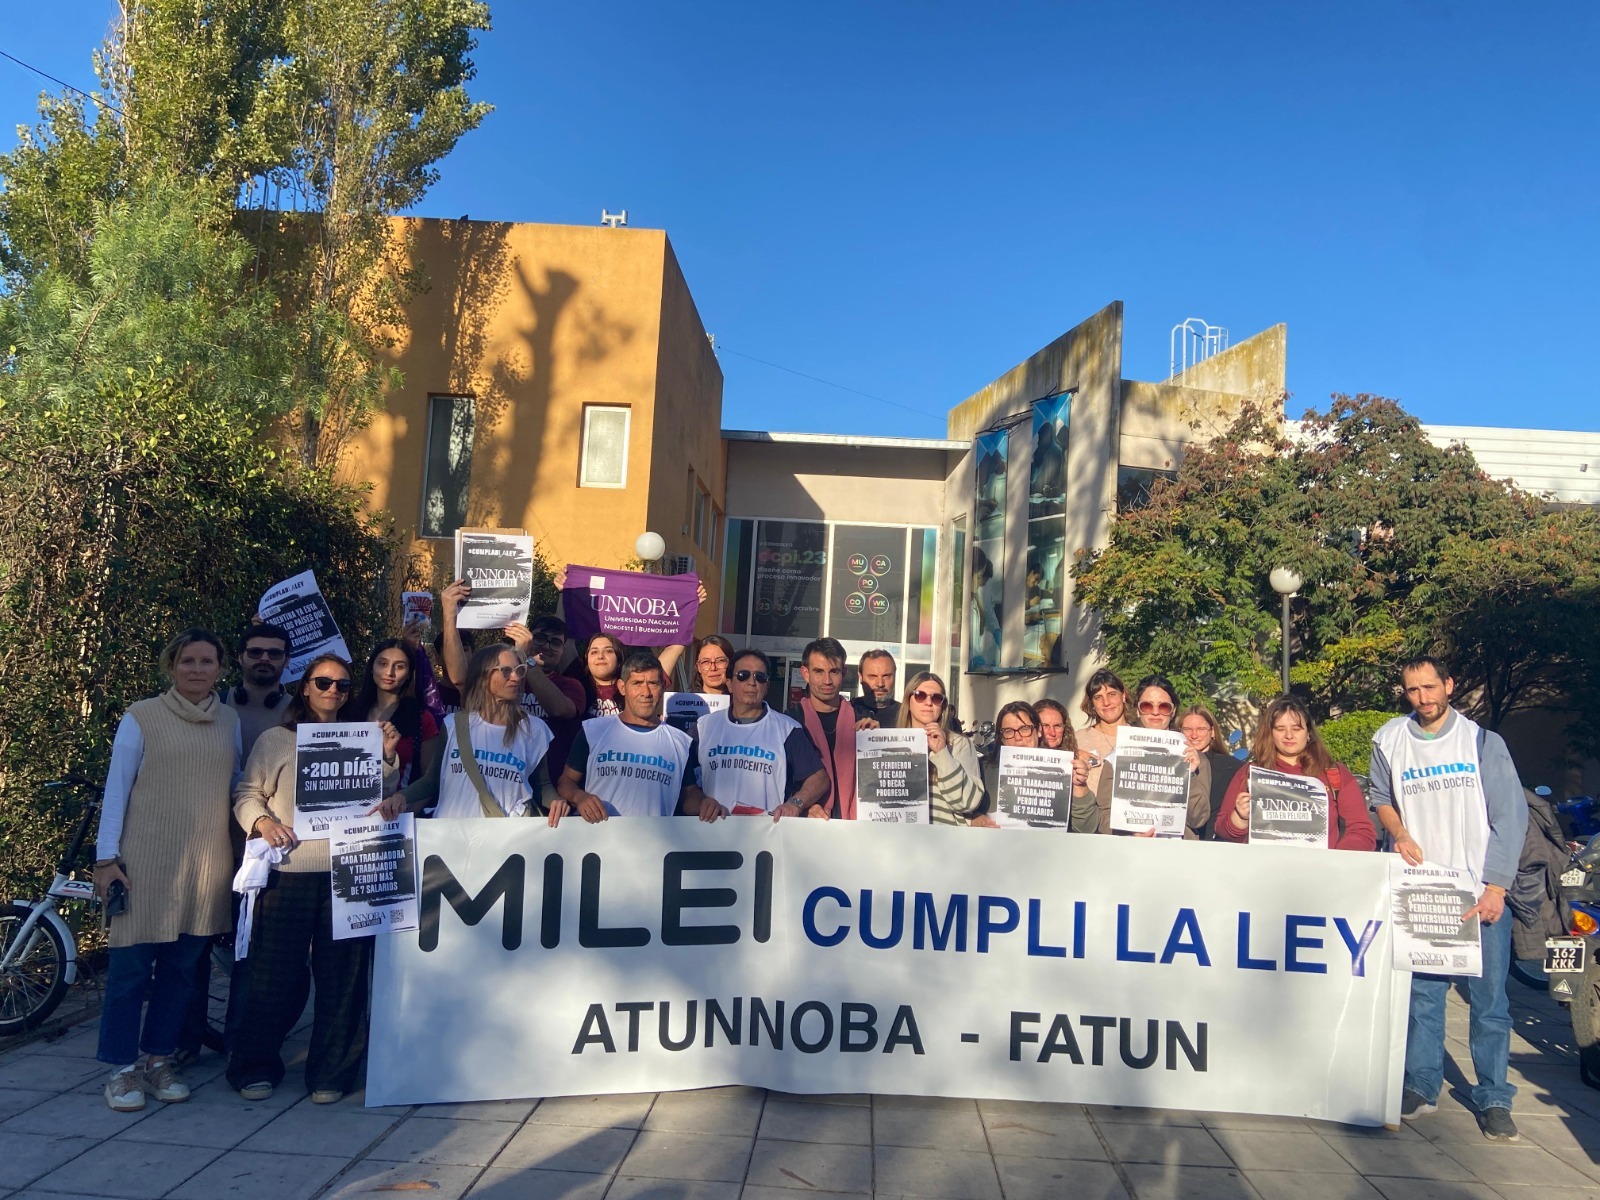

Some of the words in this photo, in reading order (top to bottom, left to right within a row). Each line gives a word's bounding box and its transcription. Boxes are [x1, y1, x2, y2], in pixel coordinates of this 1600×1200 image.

[589, 593, 681, 617] UNNOBA
[295, 607, 305, 617] YA
[604, 615, 648, 624] UNIVERSIDAD
[648, 618, 680, 626] NACIONAL
[604, 623, 634, 632] NOROESTE
[312, 730, 369, 738] #CUMPLANLALEY
[708, 744, 776, 761] atunnoba
[302, 762, 339, 778] +200
[343, 757, 378, 776] DÍAS
[596, 749, 676, 773] atunnoba
[721, 758, 732, 769] NO
[733, 758, 774, 775] DOCENTES
[872, 761, 880, 770] SE
[880, 761, 912, 770] PERDIERON
[883, 770, 891, 779] DE
[891, 770, 906, 779] CADA
[1129, 763, 1137, 771] LE
[1137, 764, 1167, 775] QUITARON
[1167, 766, 1176, 775] LA
[596, 765, 618, 777] 100%
[620, 765, 633, 778] NO
[635, 768, 673, 787] DOCENTES
[1120, 771, 1138, 780] MITAD
[1140, 773, 1147, 781] DE
[1148, 774, 1160, 783] LOS
[1160, 776, 1184, 786] FONDOS
[305, 780, 317, 792] SIN
[319, 778, 350, 791] CUMPLIR
[352, 778, 361, 789] LA
[362, 778, 374, 789] LEY
[887, 780, 906, 788] BECAS
[1007, 776, 1022, 786] CADA
[1023, 778, 1064, 790] TRABAJADORA
[1136, 783, 1184, 795] UNIVERSIDADES
[1428, 780, 1441, 792] NO
[876, 789, 909, 797] PROGRESAR
[1013, 786, 1019, 795] Y
[1019, 787, 1056, 799] TRABAJADOR
[1017, 795, 1038, 806] PERDIÓ
[1038, 796, 1052, 808] MÁS
[1013, 806, 1021, 814] DE
[1021, 807, 1026, 815] 7
[1026, 807, 1055, 818] SALARIOS
[343, 822, 400, 835] #CUMPLANLALEY
[340, 855, 359, 866] CADA
[360, 849, 406, 863] TRABAJADORA
[349, 866, 355, 875] Y
[355, 861, 398, 875] TRABAJADOR
[354, 870, 378, 885] PERDIÓ
[379, 871, 394, 882] MÁS
[350, 886, 360, 896] DE
[360, 885, 365, 895] 7
[366, 881, 398, 893] SALARIOS
[418, 850, 774, 953] MILEI
[1409, 904, 1445, 914] PERDIERON
[1448, 906, 1462, 915] LAS
[802, 886, 1087, 960] CUMPLI
[1116, 904, 1211, 967] LA
[1237, 912, 1383, 977] LEY
[1413, 924, 1460, 936] NACIONALES?
[1553, 948, 1576, 959] 162
[1551, 959, 1576, 969] KKK
[572, 997, 925, 1055] ATUNNOBA
[1009, 1010, 1208, 1073] FATUN
